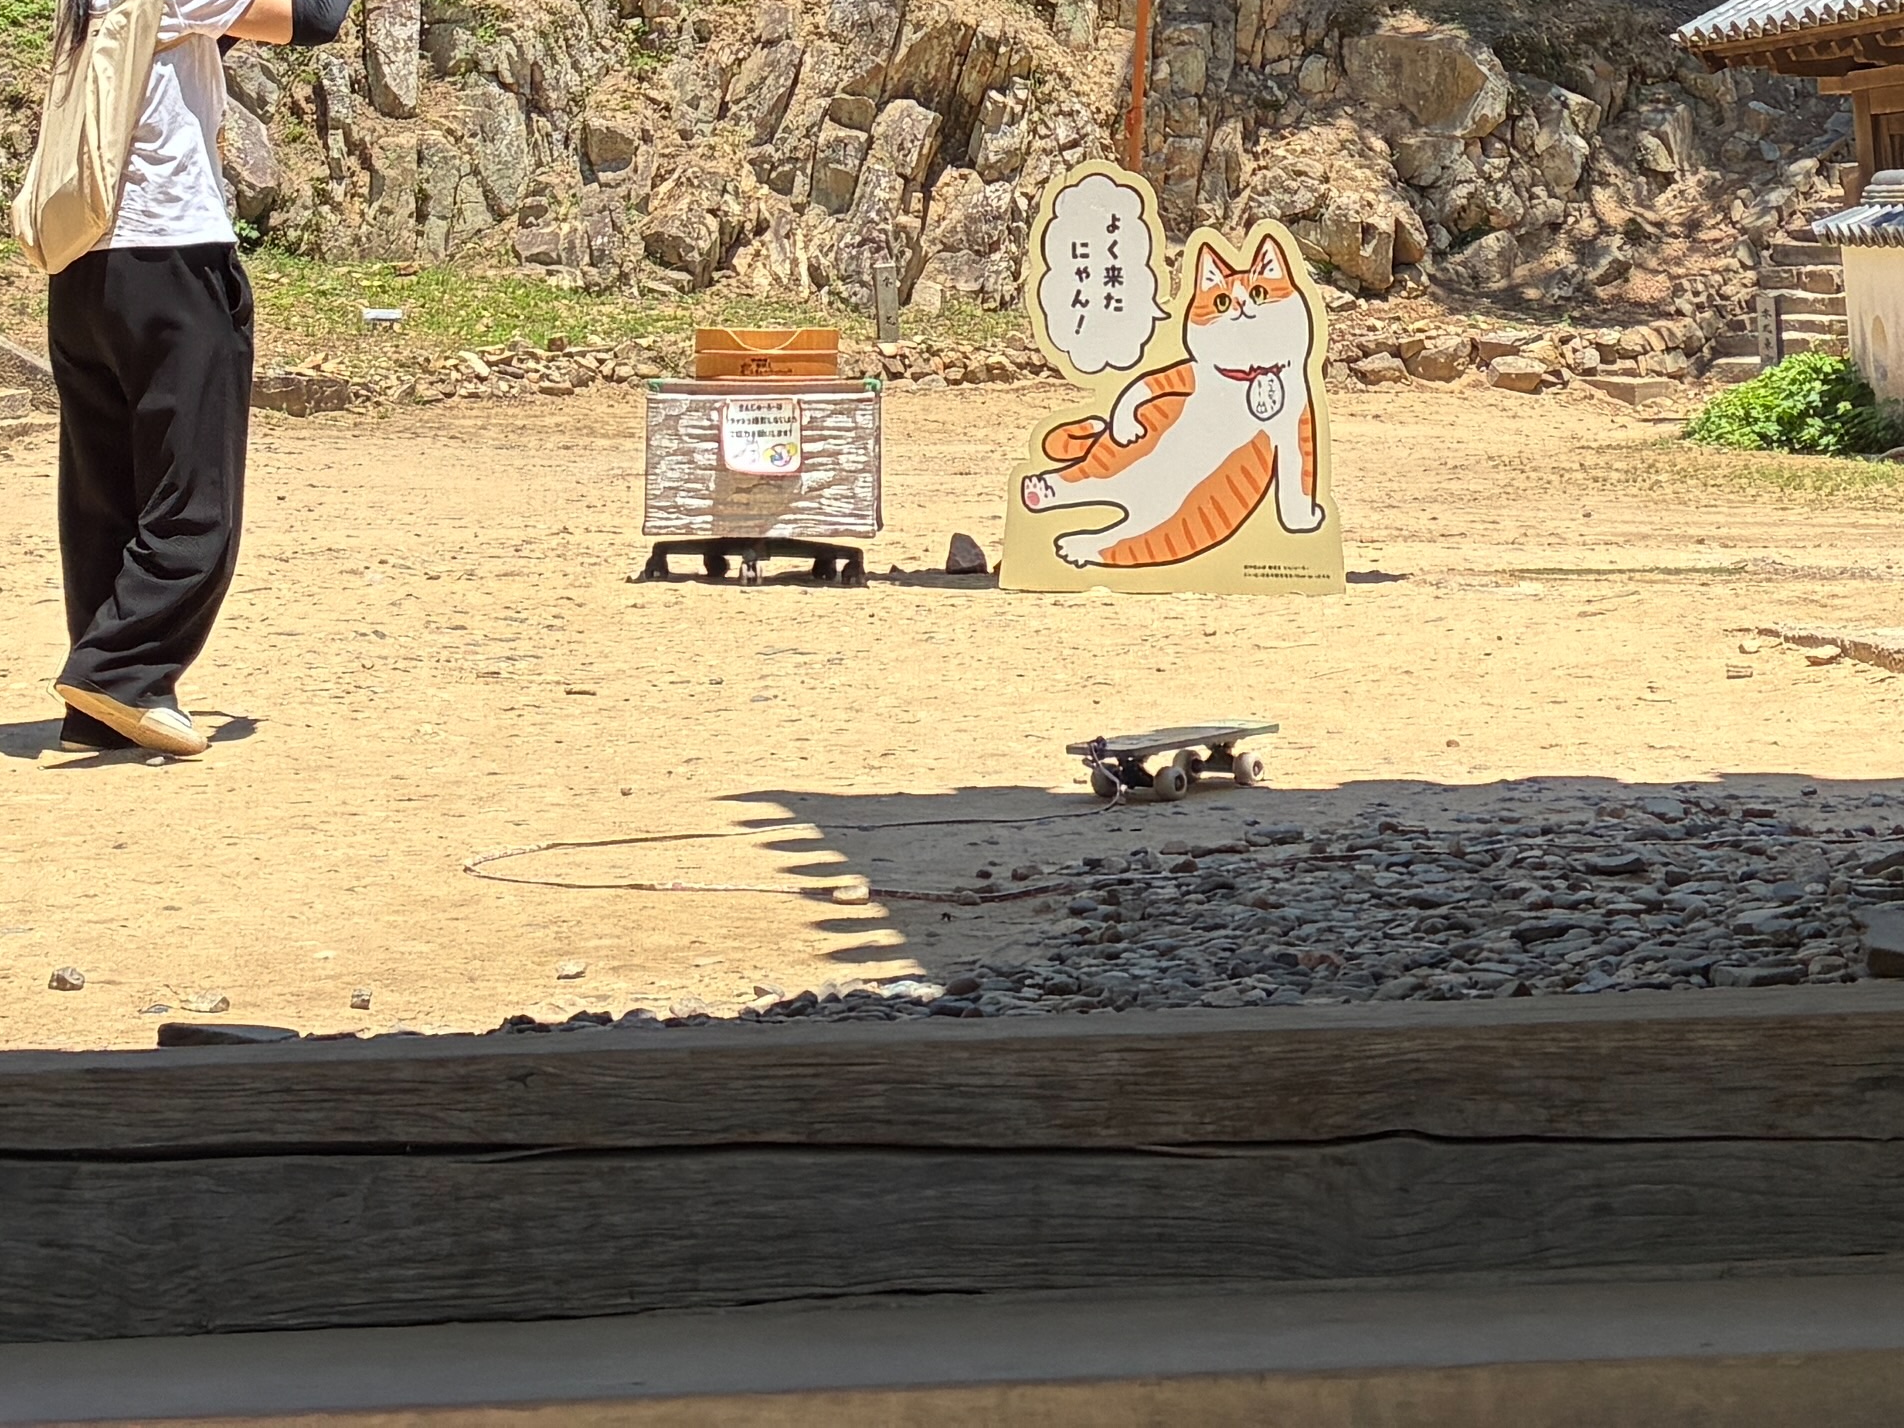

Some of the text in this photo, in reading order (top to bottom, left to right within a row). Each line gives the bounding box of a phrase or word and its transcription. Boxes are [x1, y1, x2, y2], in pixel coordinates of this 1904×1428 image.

[1071, 240, 1091, 335] にゃん！
[1103, 213, 1124, 312] よく来た
